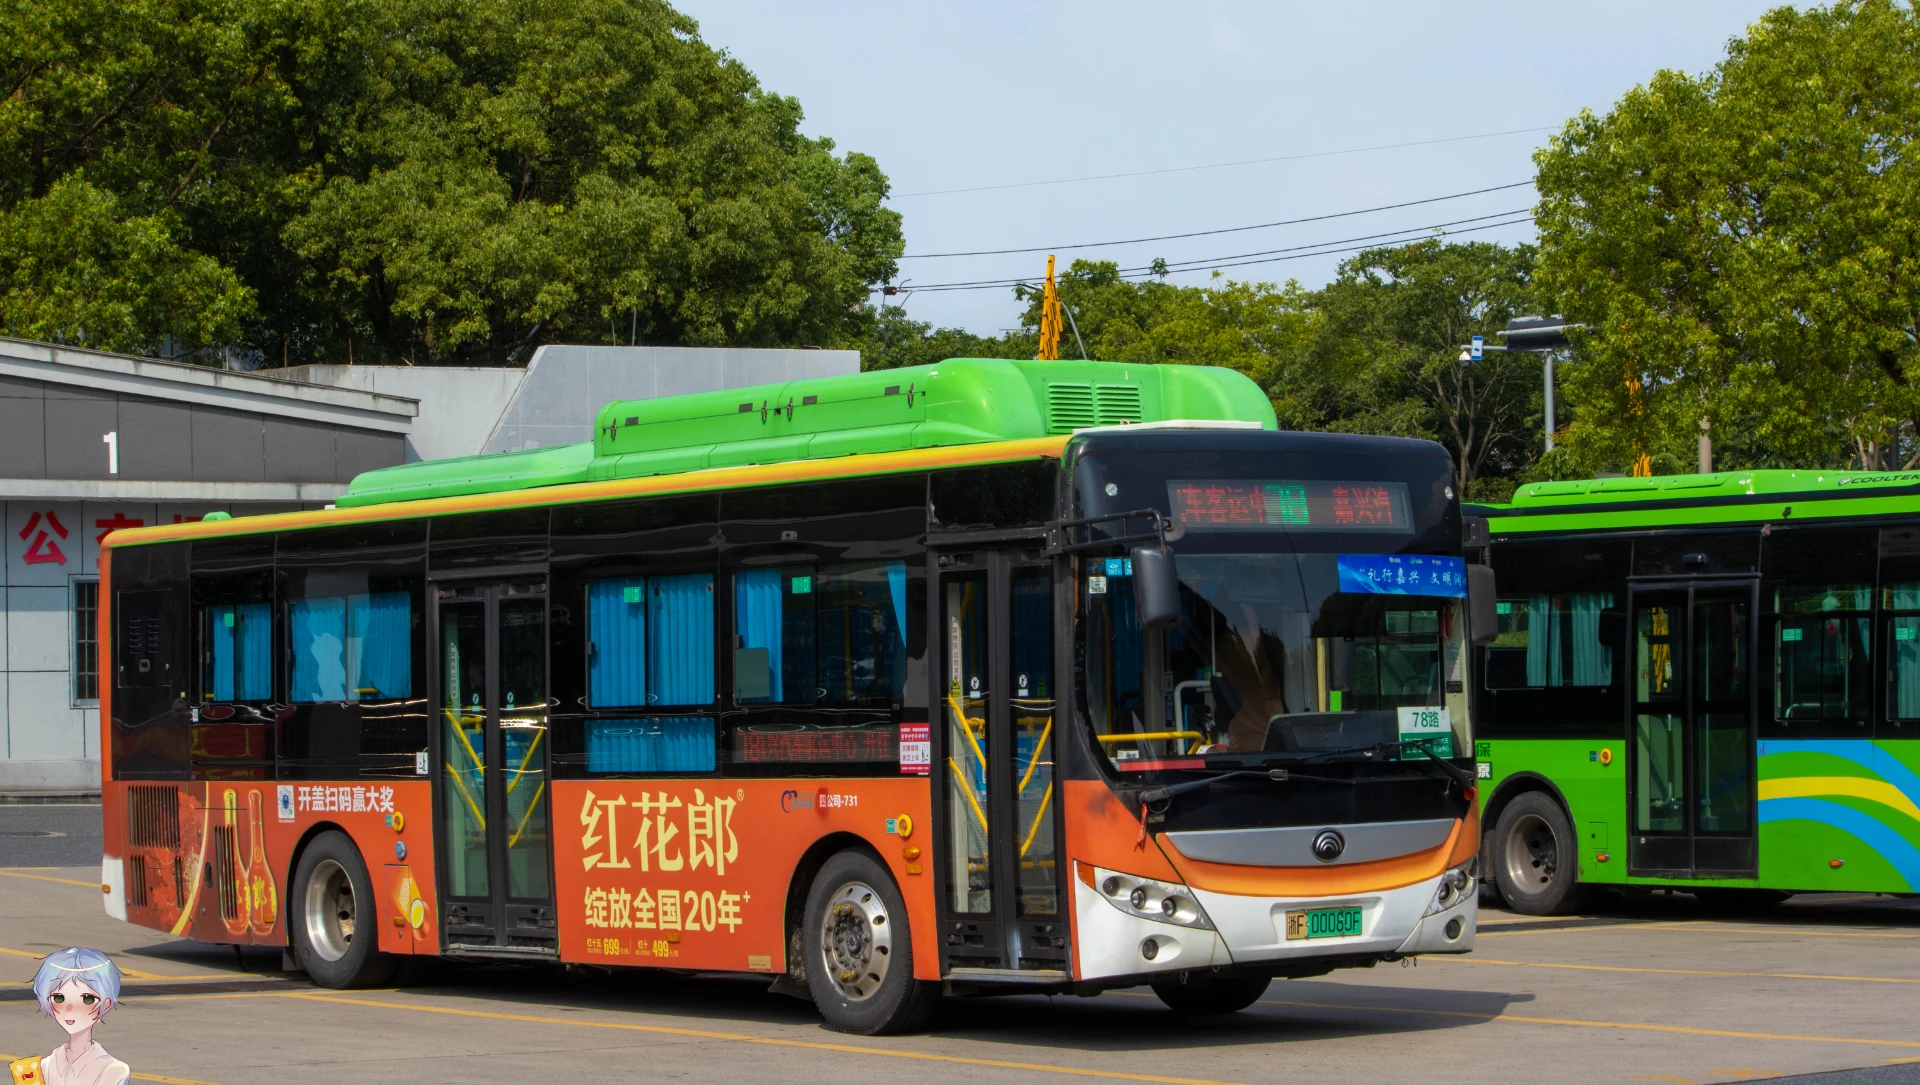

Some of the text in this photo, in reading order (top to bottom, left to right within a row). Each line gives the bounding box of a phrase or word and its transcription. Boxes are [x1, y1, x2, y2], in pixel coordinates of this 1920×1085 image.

[102, 431, 118, 474] 1
[1265, 484, 1310, 524] 78
[1412, 711, 1439, 728] 78路
[297, 785, 395, 813] 开盖扫码赢大奖
[819, 794, 858, 808] 四公司-731
[603, 937, 620, 956] 699
[637, 940, 649, 949] 红十
[652, 939, 669, 958] 499
